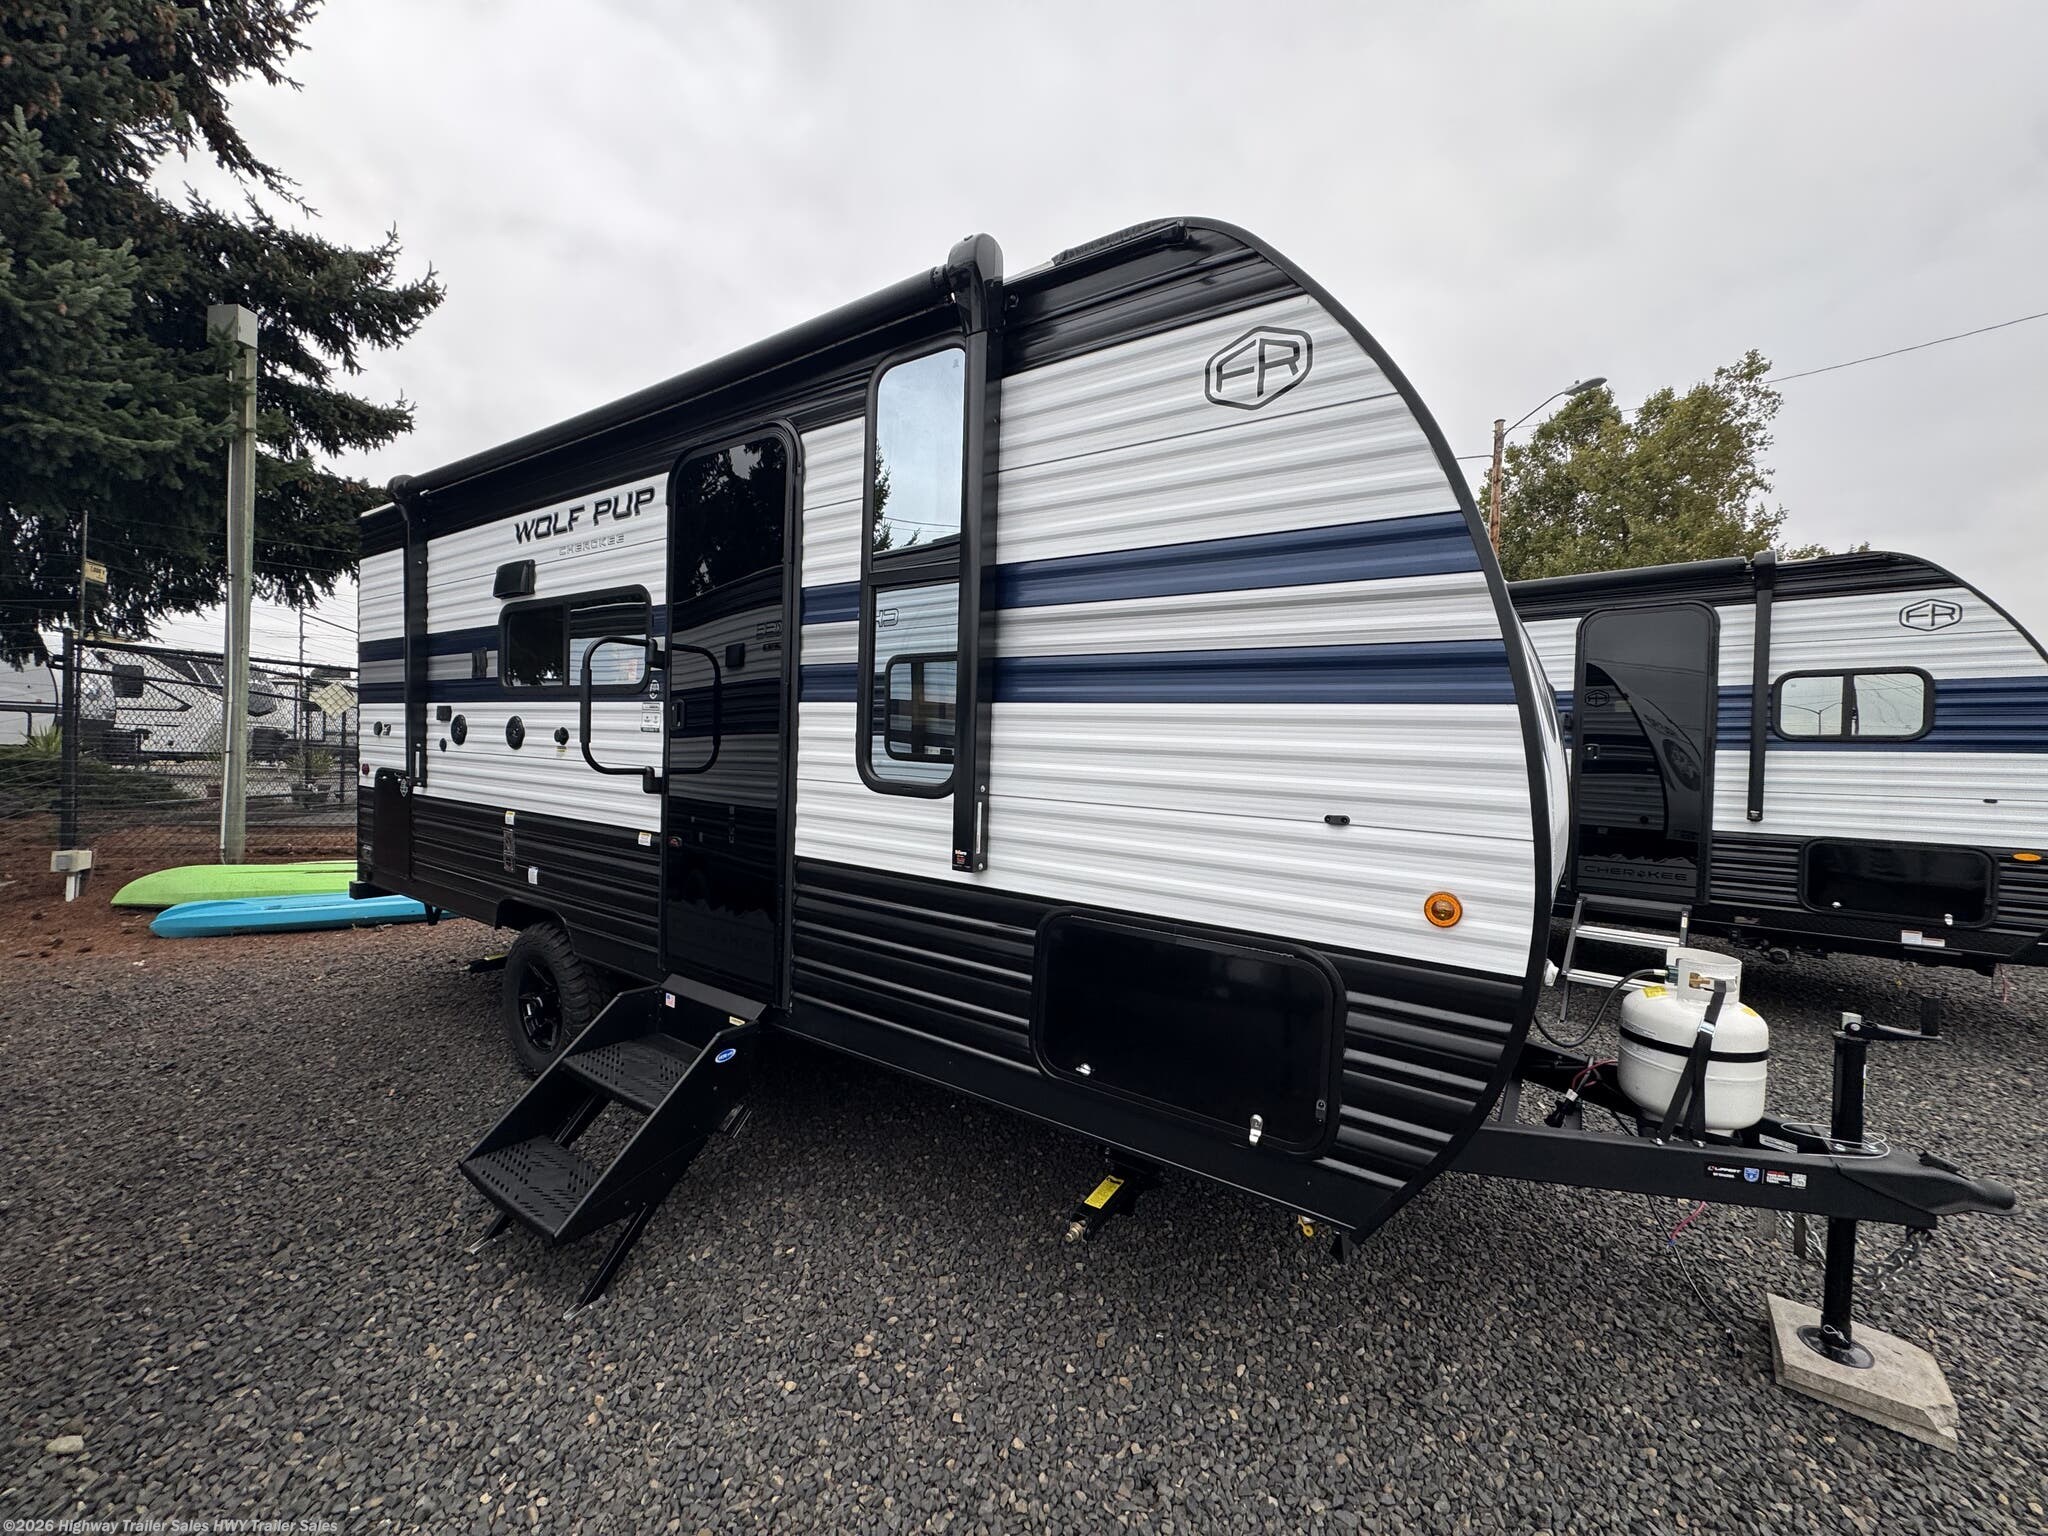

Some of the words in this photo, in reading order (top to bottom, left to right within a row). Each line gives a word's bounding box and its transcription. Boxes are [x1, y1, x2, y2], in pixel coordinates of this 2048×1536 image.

[1214, 337, 1301, 398] FR
[514, 504, 586, 544] WOLF
[592, 486, 656, 526] PUP
[558, 534, 626, 556] CHEROKEE
[1583, 865, 1689, 881] CHEROKEE
